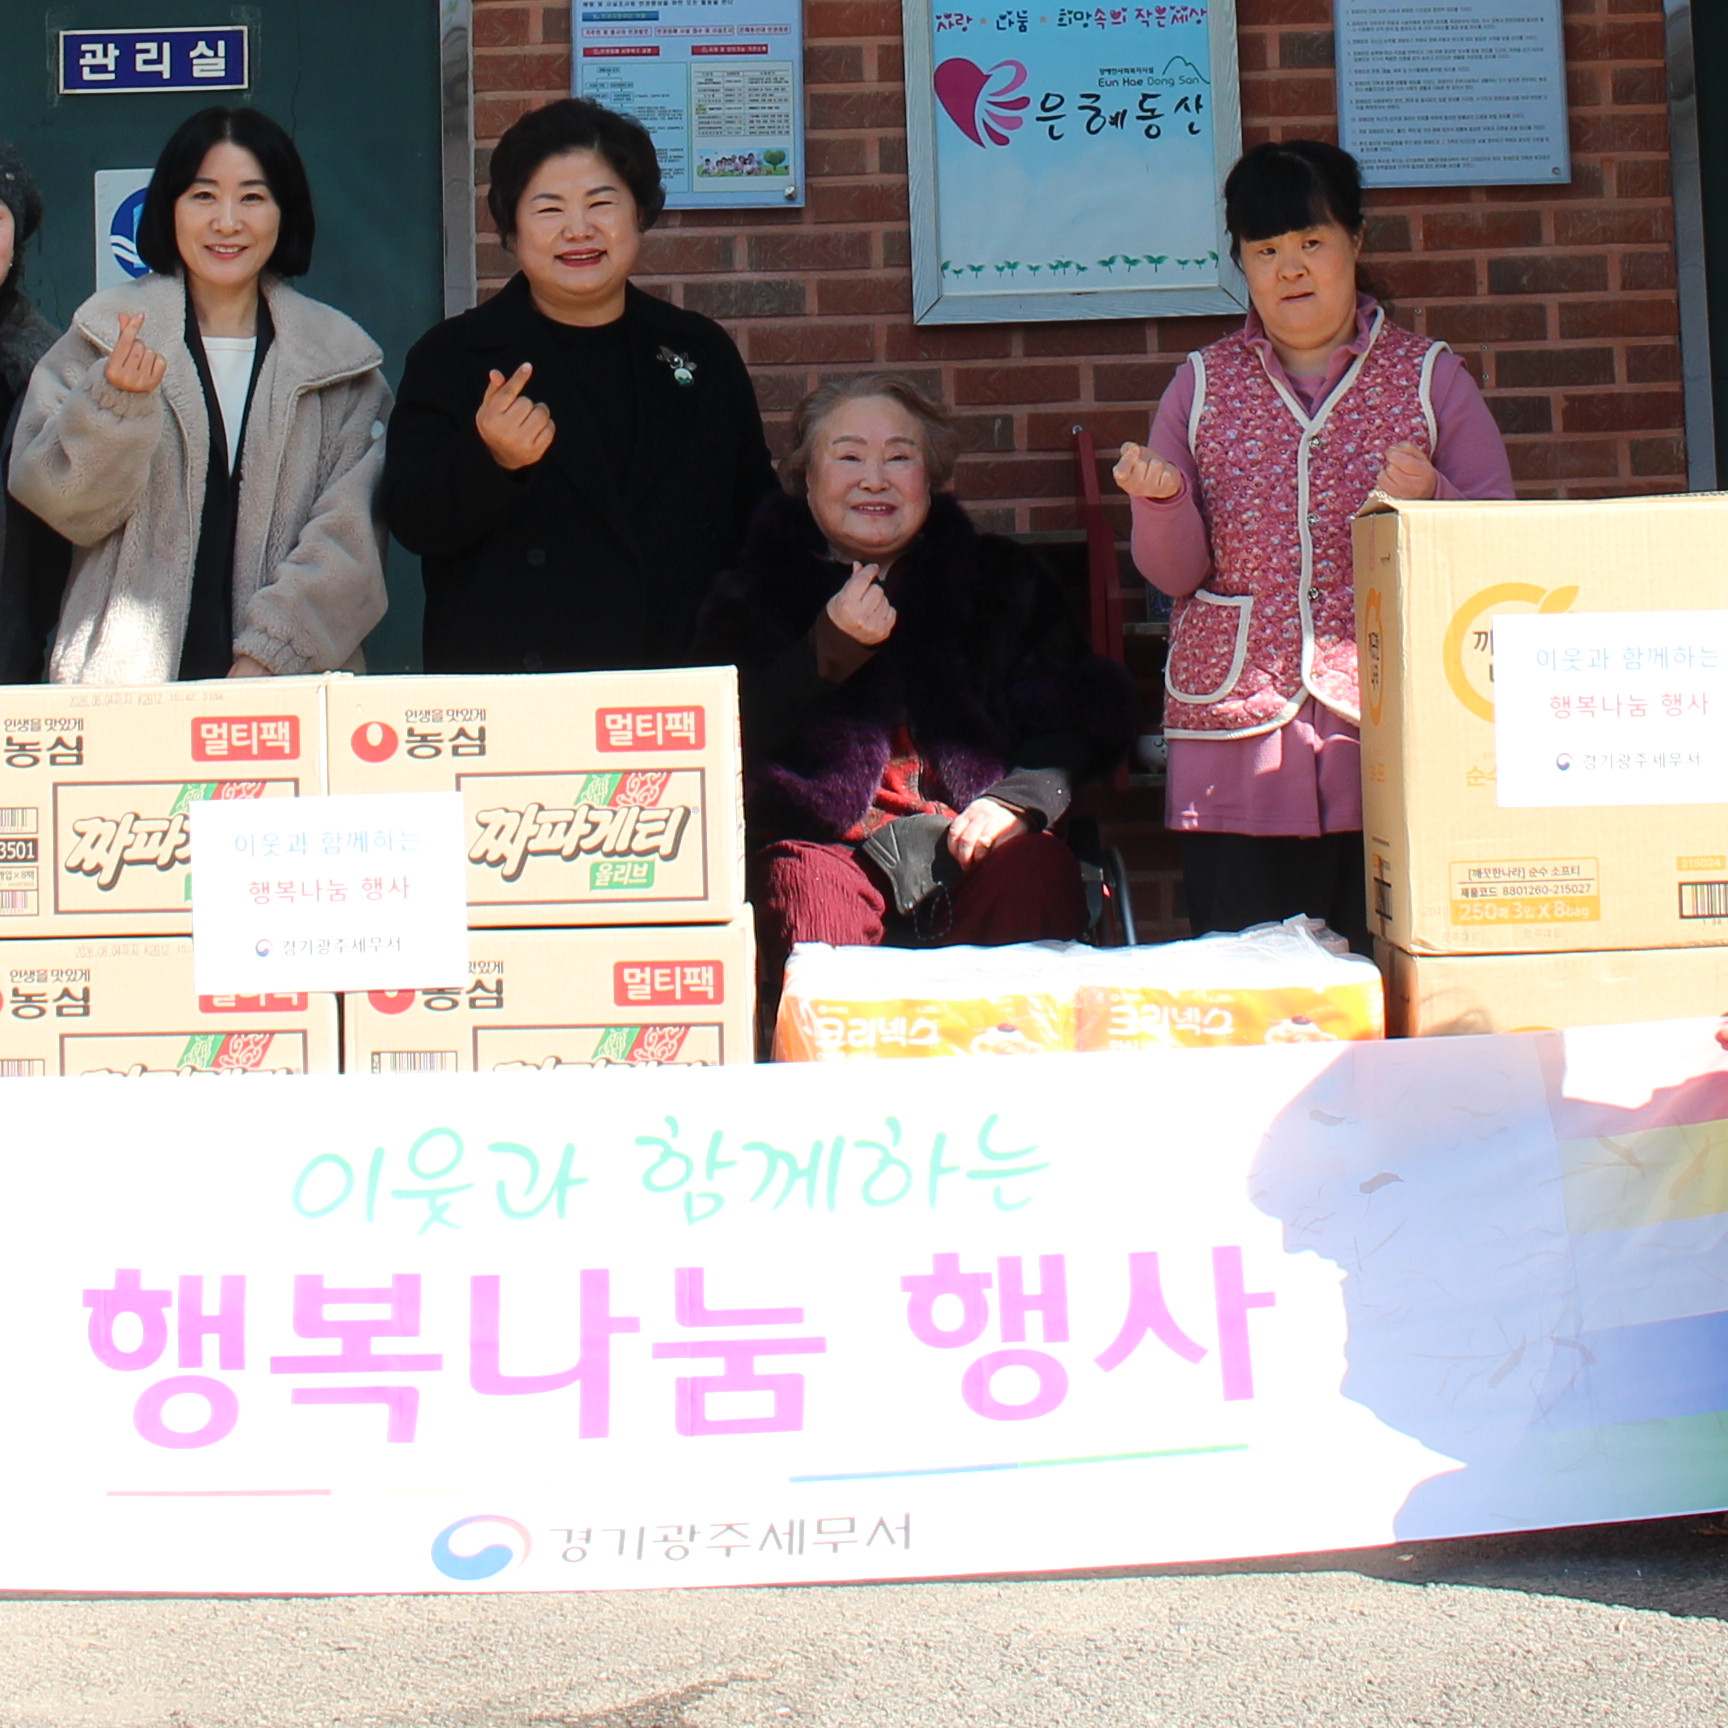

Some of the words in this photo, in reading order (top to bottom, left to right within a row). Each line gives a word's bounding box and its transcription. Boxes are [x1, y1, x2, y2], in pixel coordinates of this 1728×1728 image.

[936, 12, 972, 32] 사랑
[996, 10, 1028, 33] 나눔
[79, 40, 227, 81] 관리실
[1098, 78, 1119, 87] Eun
[1148, 76, 1175, 88] Dong
[1179, 75, 1200, 85] San
[1035, 92, 1203, 141] 은혜동산
[1536, 647, 1610, 671] 이웃과
[1623, 645, 1719, 670] 함께하는
[404, 709, 443, 723] 인생을
[446, 708, 487, 722] 맛있게
[1550, 694, 1648, 719] 행복나눔
[1661, 692, 1708, 716] 행사
[4, 718, 41, 731] 인생을
[44, 718, 84, 732] 맛있게
[200, 721, 290, 755] 멀티팩
[604, 711, 696, 746] 멀티팩
[3, 735, 84, 768] 농심
[404, 725, 487, 760] 농심
[1583, 752, 1700, 770] 경기광주세무서
[235, 832, 308, 856] 이웃과
[322, 830, 419, 855] 함께하는
[468, 803, 691, 882] 짜파게티
[249, 879, 348, 905] 행복나눔
[361, 876, 410, 901] 행사
[594, 862, 648, 887] 올리브
[282, 936, 401, 956] 경기광주세무서
[10, 969, 47, 983] 인생을
[51, 969, 91, 983] 맛있게
[623, 965, 714, 1000] 멀티팩
[9, 986, 91, 1020] 농심
[1107, 1003, 1235, 1036] 크리넥스
[293, 1126, 589, 1236] 이웃과
[635, 1112, 1051, 1225] 함께하는
[82, 1266, 826, 1450] 행복나눔
[900, 1244, 1275, 1422] 행사
[550, 1512, 911, 1562] 경기광주세무서
